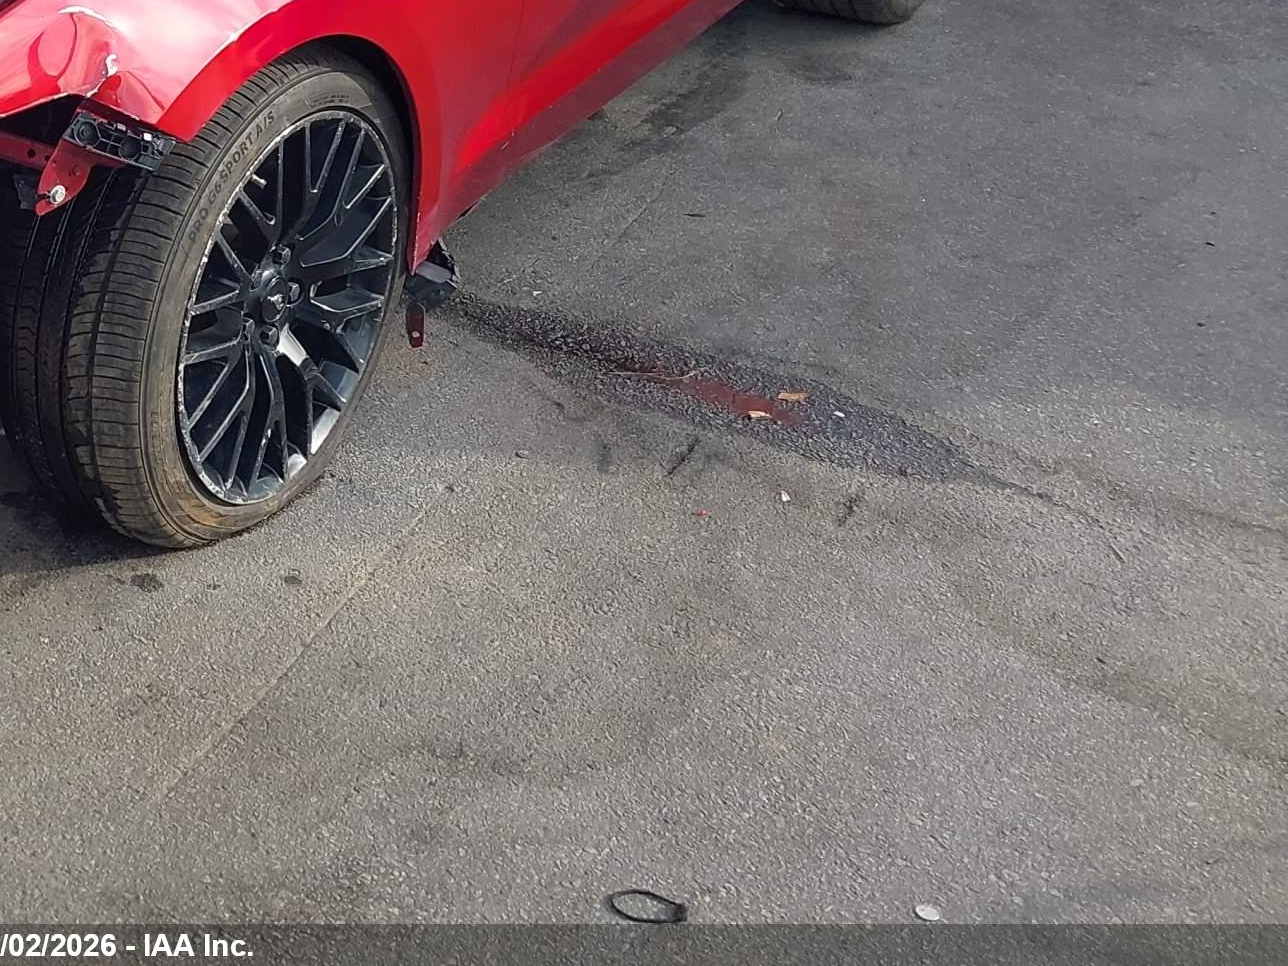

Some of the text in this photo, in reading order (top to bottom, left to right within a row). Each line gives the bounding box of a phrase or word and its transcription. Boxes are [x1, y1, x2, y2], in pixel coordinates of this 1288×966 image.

[188, 208, 209, 246] PRO
[219, 132, 255, 183] SPORT
[255, 110, 276, 137] A/S
